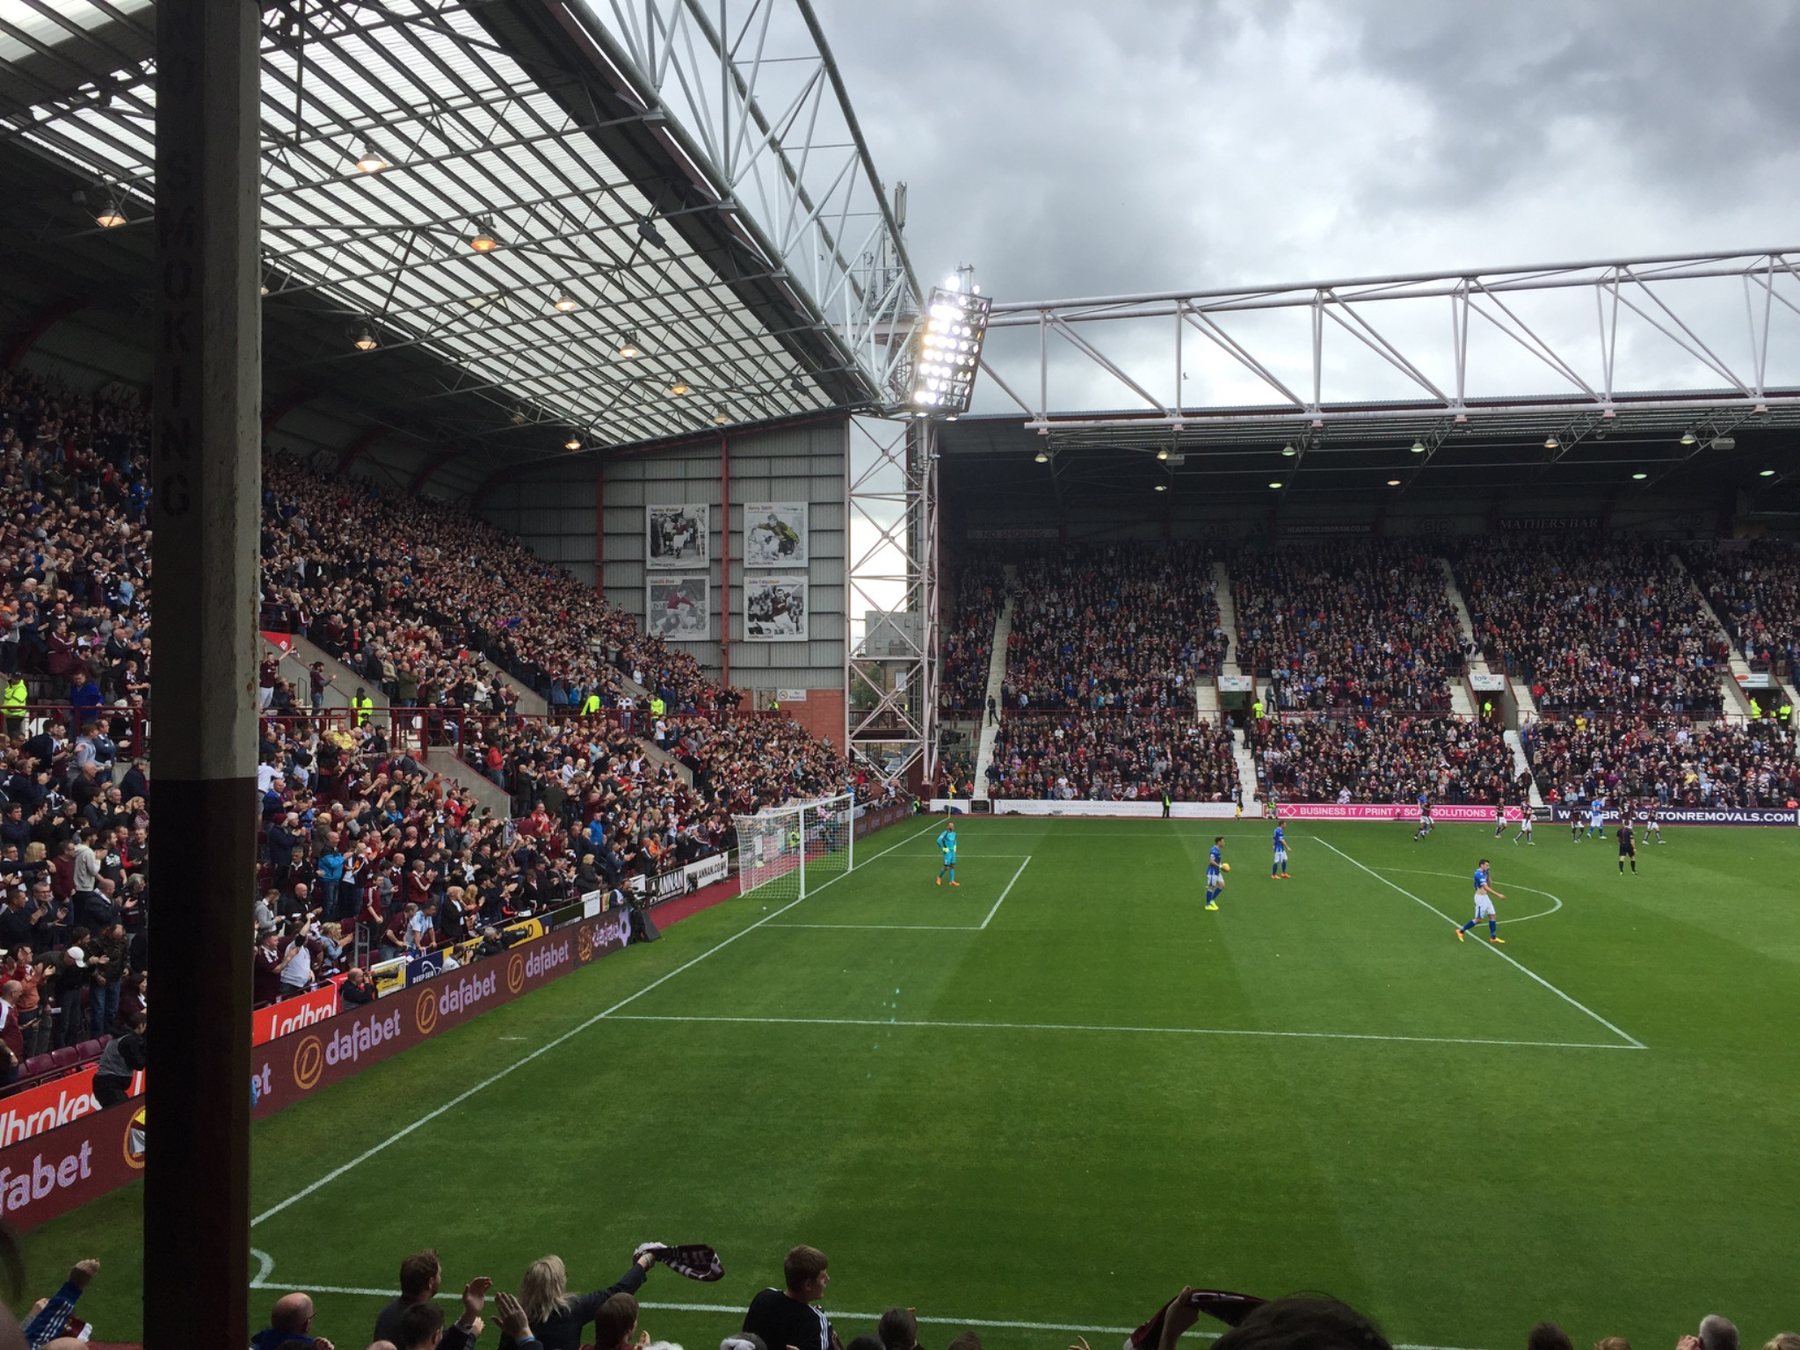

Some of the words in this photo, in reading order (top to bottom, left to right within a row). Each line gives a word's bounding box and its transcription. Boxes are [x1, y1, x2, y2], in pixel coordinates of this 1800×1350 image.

[1500, 518, 1566, 529] MATHERS
[1569, 518, 1598, 528] BAR
[1300, 806, 1345, 816] BUSINESS
[1348, 807, 1357, 816] IT
[1364, 807, 1392, 816] PRINT
[1403, 808, 1422, 817] SCA
[1432, 808, 1486, 817] SOLUTIONS
[526, 940, 569, 978] dafabet
[439, 970, 497, 1016] dafabet
[325, 1008, 401, 1066] dafabet
